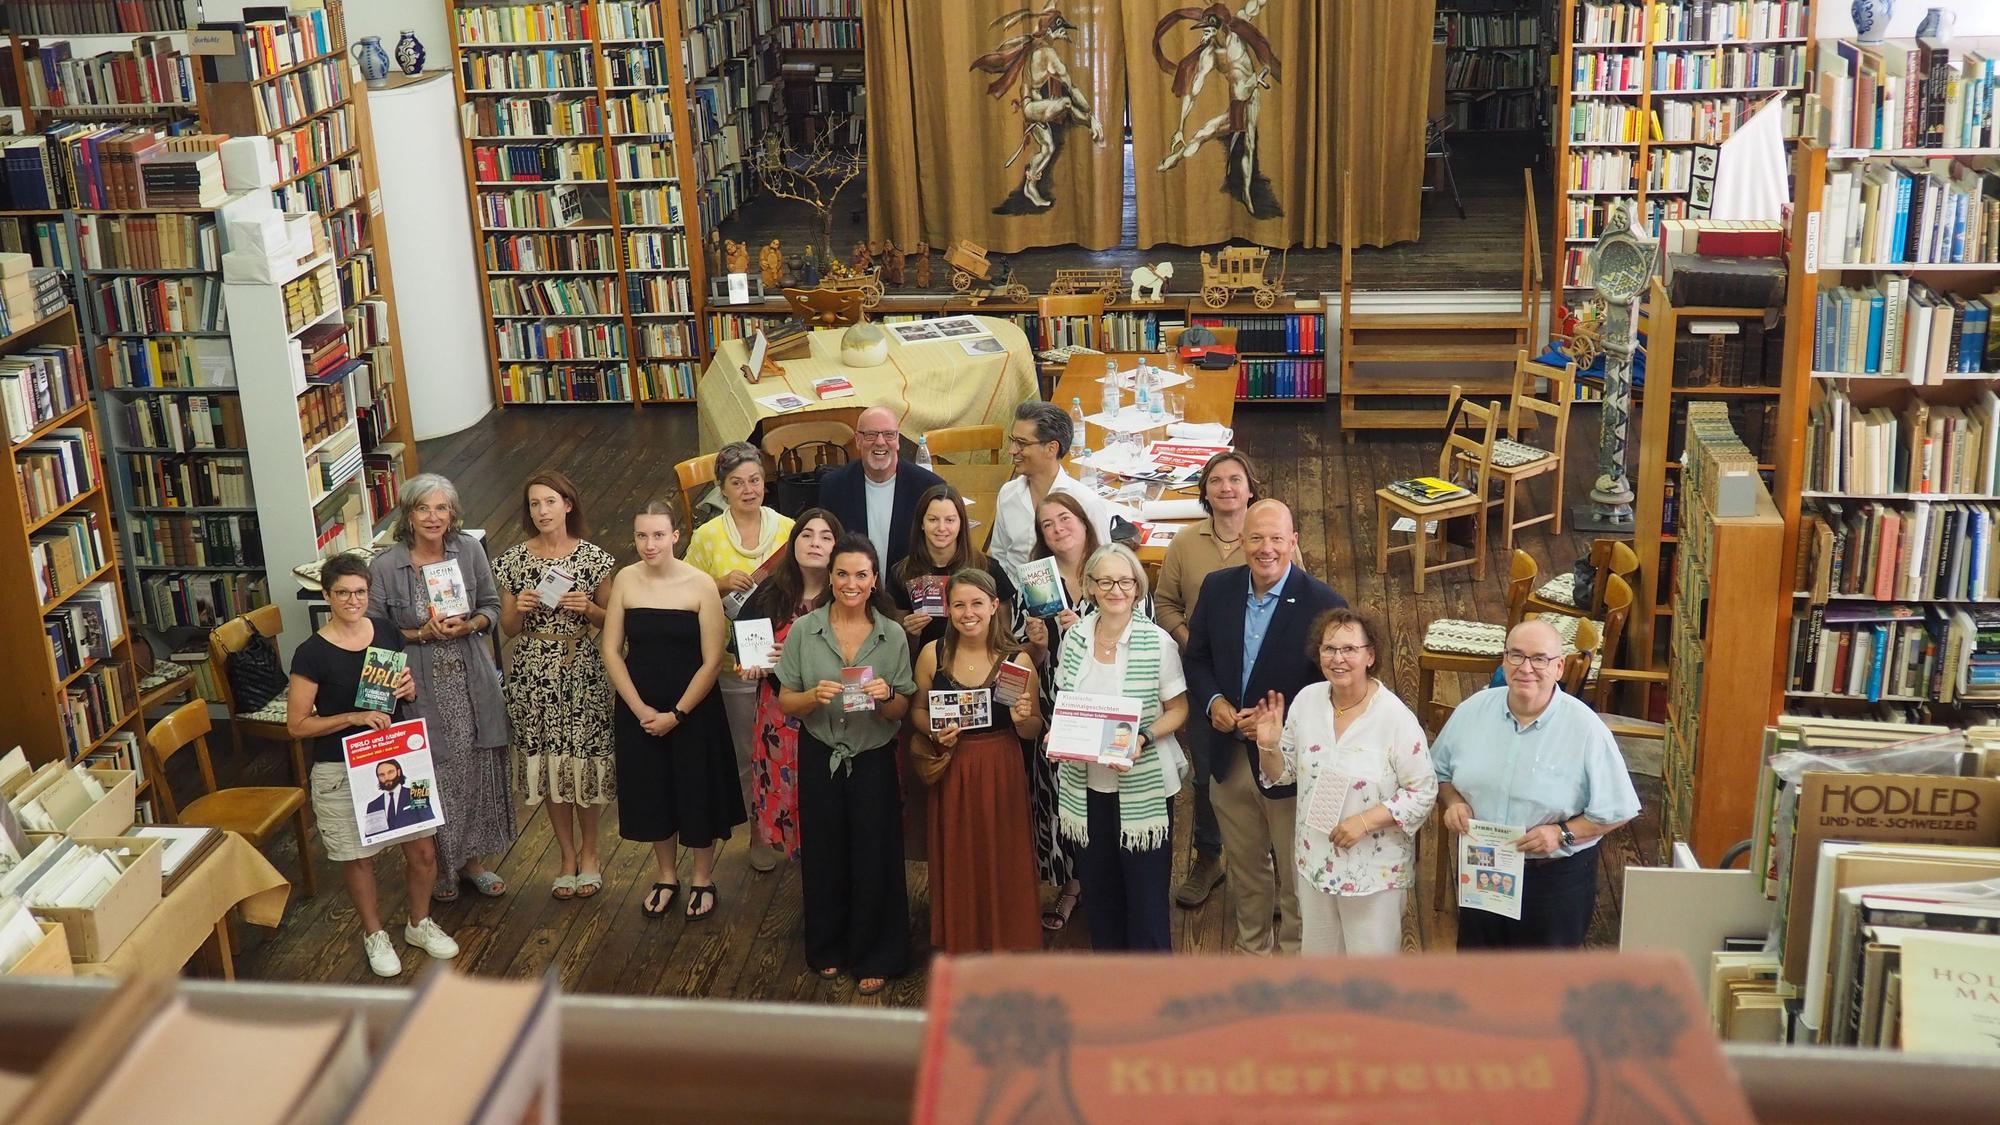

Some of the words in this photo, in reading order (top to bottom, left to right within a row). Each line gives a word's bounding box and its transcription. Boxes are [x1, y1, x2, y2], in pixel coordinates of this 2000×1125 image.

[1807, 216, 1816, 271] EUROPA
[1028, 568, 1050, 580] MACHT
[362, 664, 401, 689] PIRLO
[1061, 702, 1120, 712] Kriminalgeschichten
[350, 739, 370, 750] PIRLO
[371, 736, 384, 744] und
[1821, 784, 1980, 817] HODLER
[1820, 816, 1850, 827] UND
[1855, 817, 1877, 828] DIE
[1885, 817, 1978, 831] SCHWEIZER
[1108, 1057, 1556, 1095] Kinderfreund
